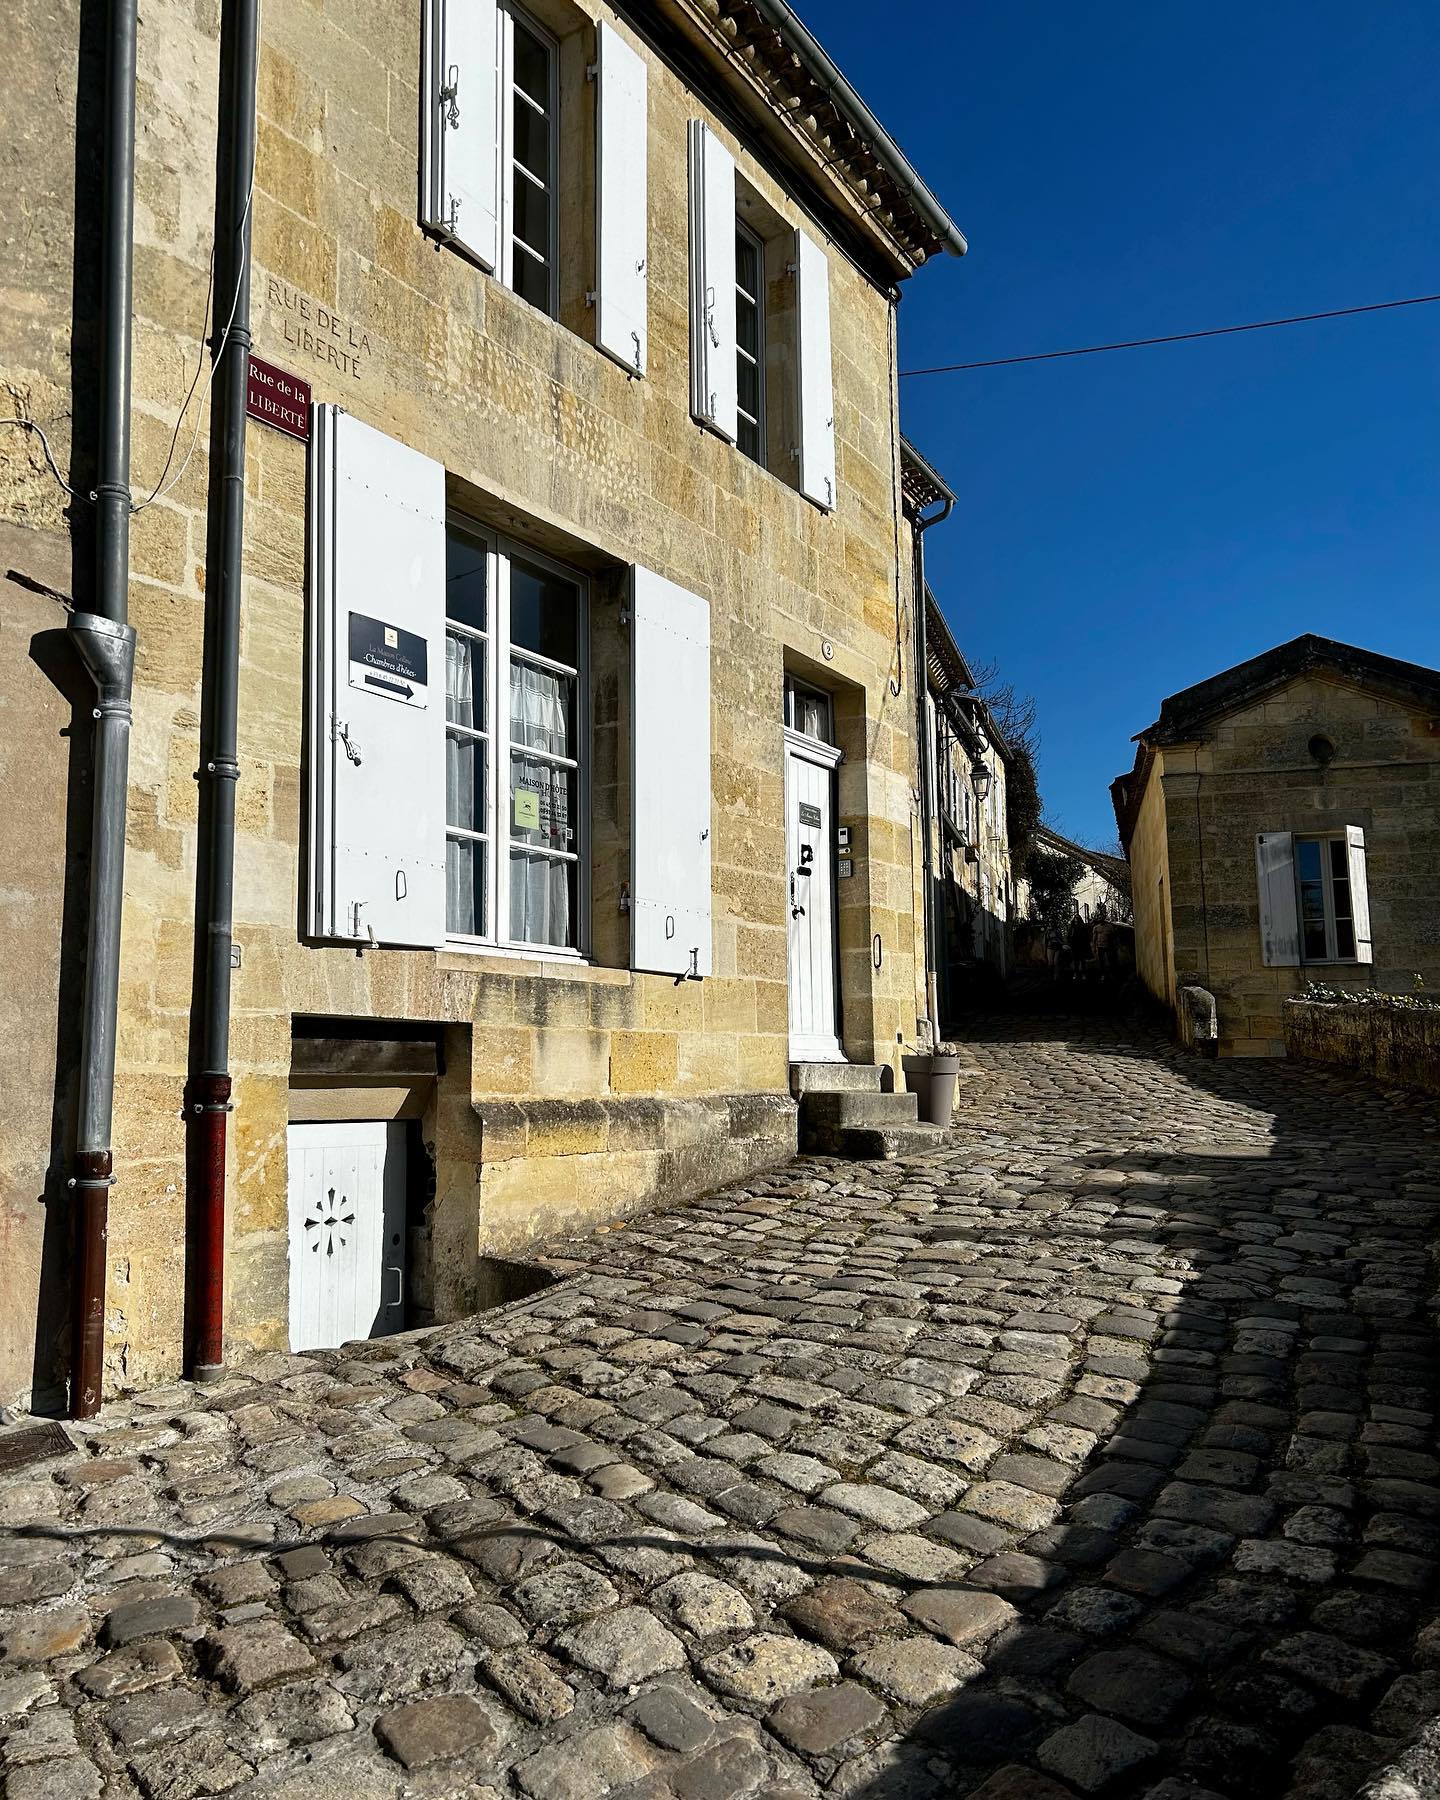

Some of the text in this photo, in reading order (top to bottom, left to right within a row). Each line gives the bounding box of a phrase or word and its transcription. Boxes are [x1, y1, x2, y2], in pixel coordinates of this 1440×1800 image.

[268, 279, 371, 356] RUE DE LA
[284, 320, 361, 380] LIBERTÉ
[249, 363, 305, 404] Rue de la
[249, 390, 305, 429] LIBERTÉ
[826, 645, 831, 656] 2
[519, 775, 544, 789] MAISON
